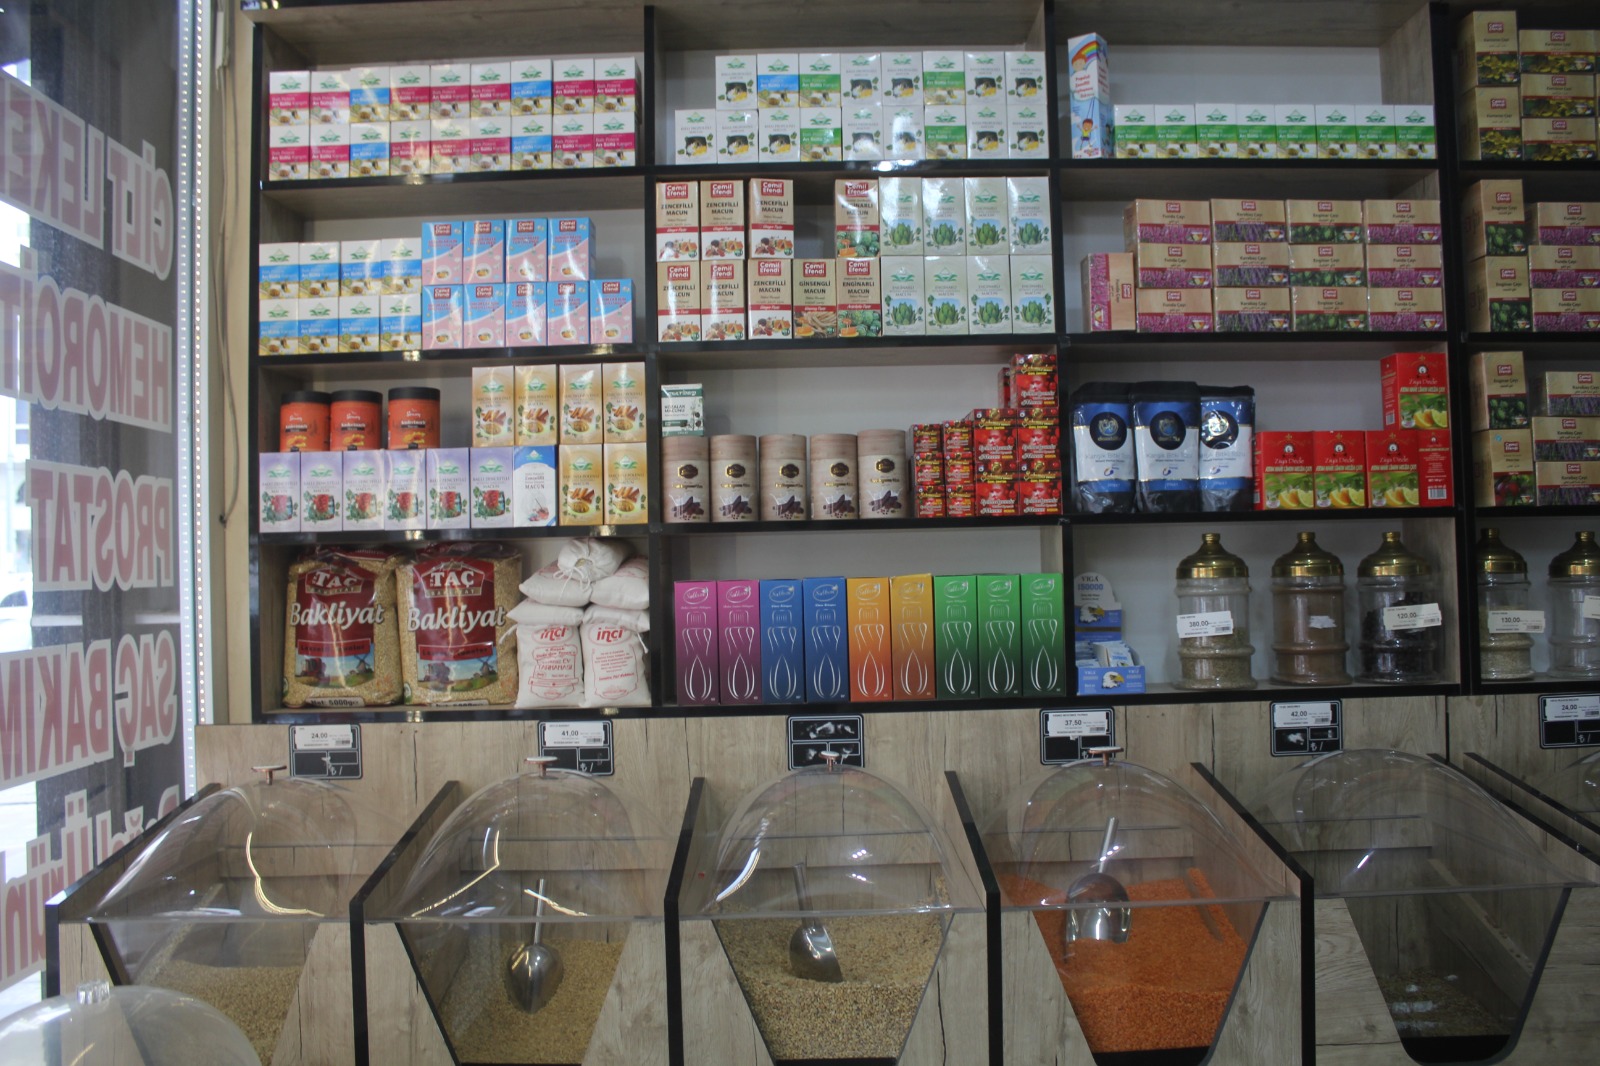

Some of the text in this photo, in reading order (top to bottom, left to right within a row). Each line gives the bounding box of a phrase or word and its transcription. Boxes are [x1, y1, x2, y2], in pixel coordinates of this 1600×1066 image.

[431, 571, 474, 588] TAÇ
[290, 602, 385, 630] Bakliyat
[407, 604, 506, 633] Bakliyat
[596, 628, 624, 642] inci
